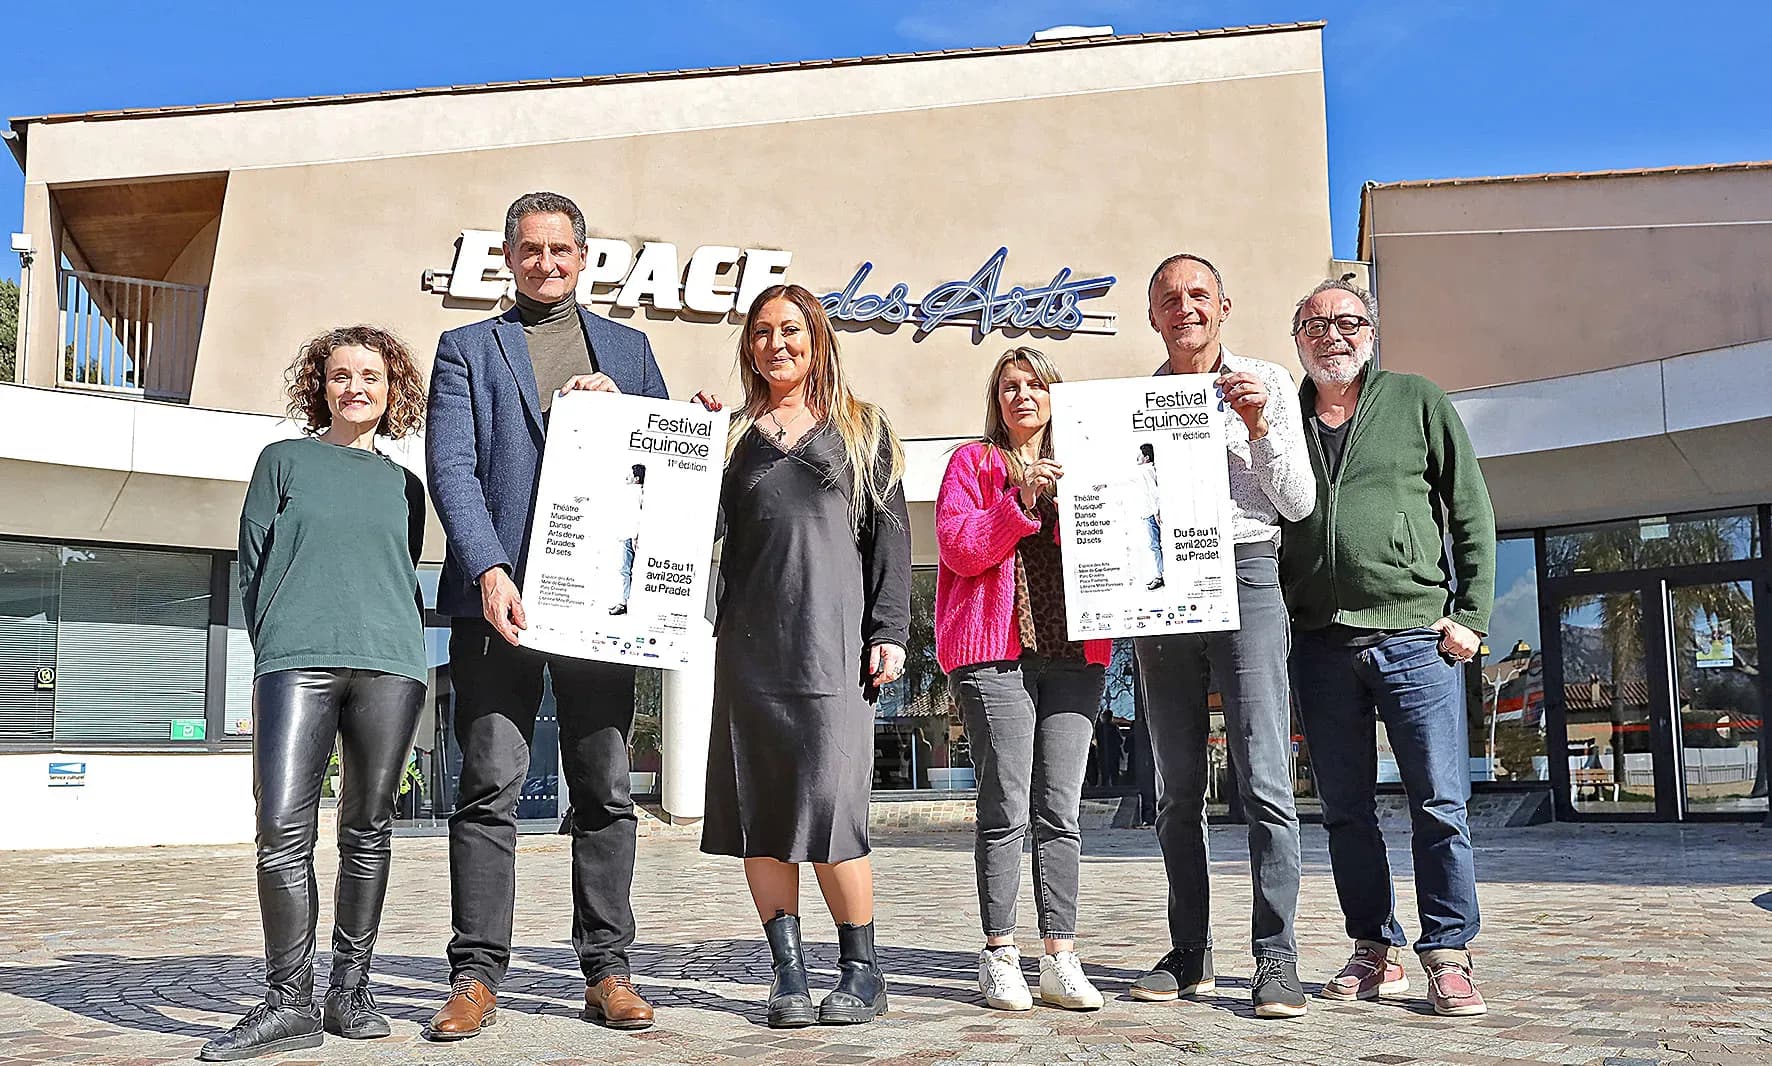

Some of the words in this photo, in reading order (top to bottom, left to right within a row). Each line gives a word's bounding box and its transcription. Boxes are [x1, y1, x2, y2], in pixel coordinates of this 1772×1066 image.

[449, 229, 793, 314] EPACE
[821, 261, 910, 323] des
[920, 246, 1117, 335] Arts
[1145, 388, 1207, 408] Festival
[647, 413, 713, 437] Festival
[1132, 409, 1209, 431] Équinoxe
[1182, 431, 1211, 440] édition
[629, 429, 709, 457] Équinoxe
[678, 460, 707, 472] édition
[1074, 494, 1100, 502] Théâtre
[552, 503, 579, 512] Théâtre
[1074, 503, 1103, 511] Musique
[550, 512, 580, 522] Musique
[1074, 512, 1097, 520] Danse
[549, 520, 572, 529] Danse
[548, 529, 562, 537] Arts
[1076, 528, 1104, 536] Parades
[1173, 528, 1187, 538] Du
[1188, 527, 1196, 537] 5
[1196, 529, 1209, 537] au
[1209, 526, 1218, 535] 11
[546, 538, 576, 548] Parades
[1076, 537, 1086, 545] DJ
[1175, 540, 1193, 550] avril
[1193, 538, 1219, 549] 2025
[545, 546, 555, 555] DJ
[556, 548, 572, 557] sets
[1175, 553, 1187, 562] au
[1188, 550, 1219, 560] Pradet
[648, 557, 662, 568] Du
[663, 559, 671, 570] 5
[671, 562, 684, 571] au
[686, 562, 694, 572] 11
[646, 571, 665, 581] avril
[666, 572, 692, 584] 2025
[644, 584, 657, 592] au
[658, 583, 691, 597] Pradet
